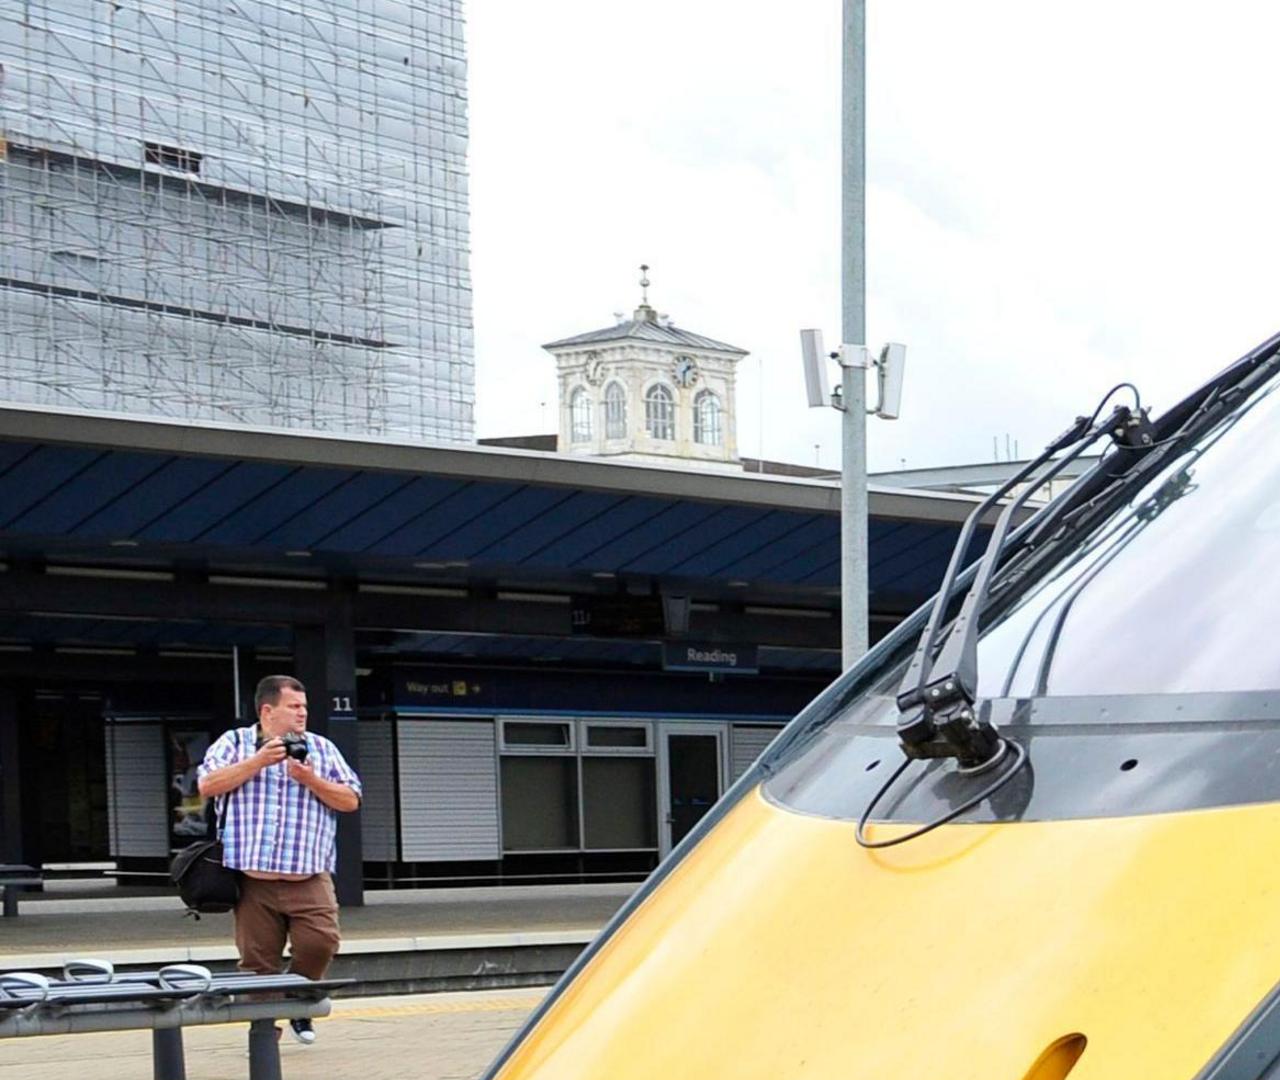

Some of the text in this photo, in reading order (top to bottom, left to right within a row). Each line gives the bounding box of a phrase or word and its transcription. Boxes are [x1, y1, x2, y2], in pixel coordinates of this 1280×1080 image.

[687, 648, 737, 666] Reading
[406, 681, 449, 695] Way out
[333, 697, 353, 712] 11
